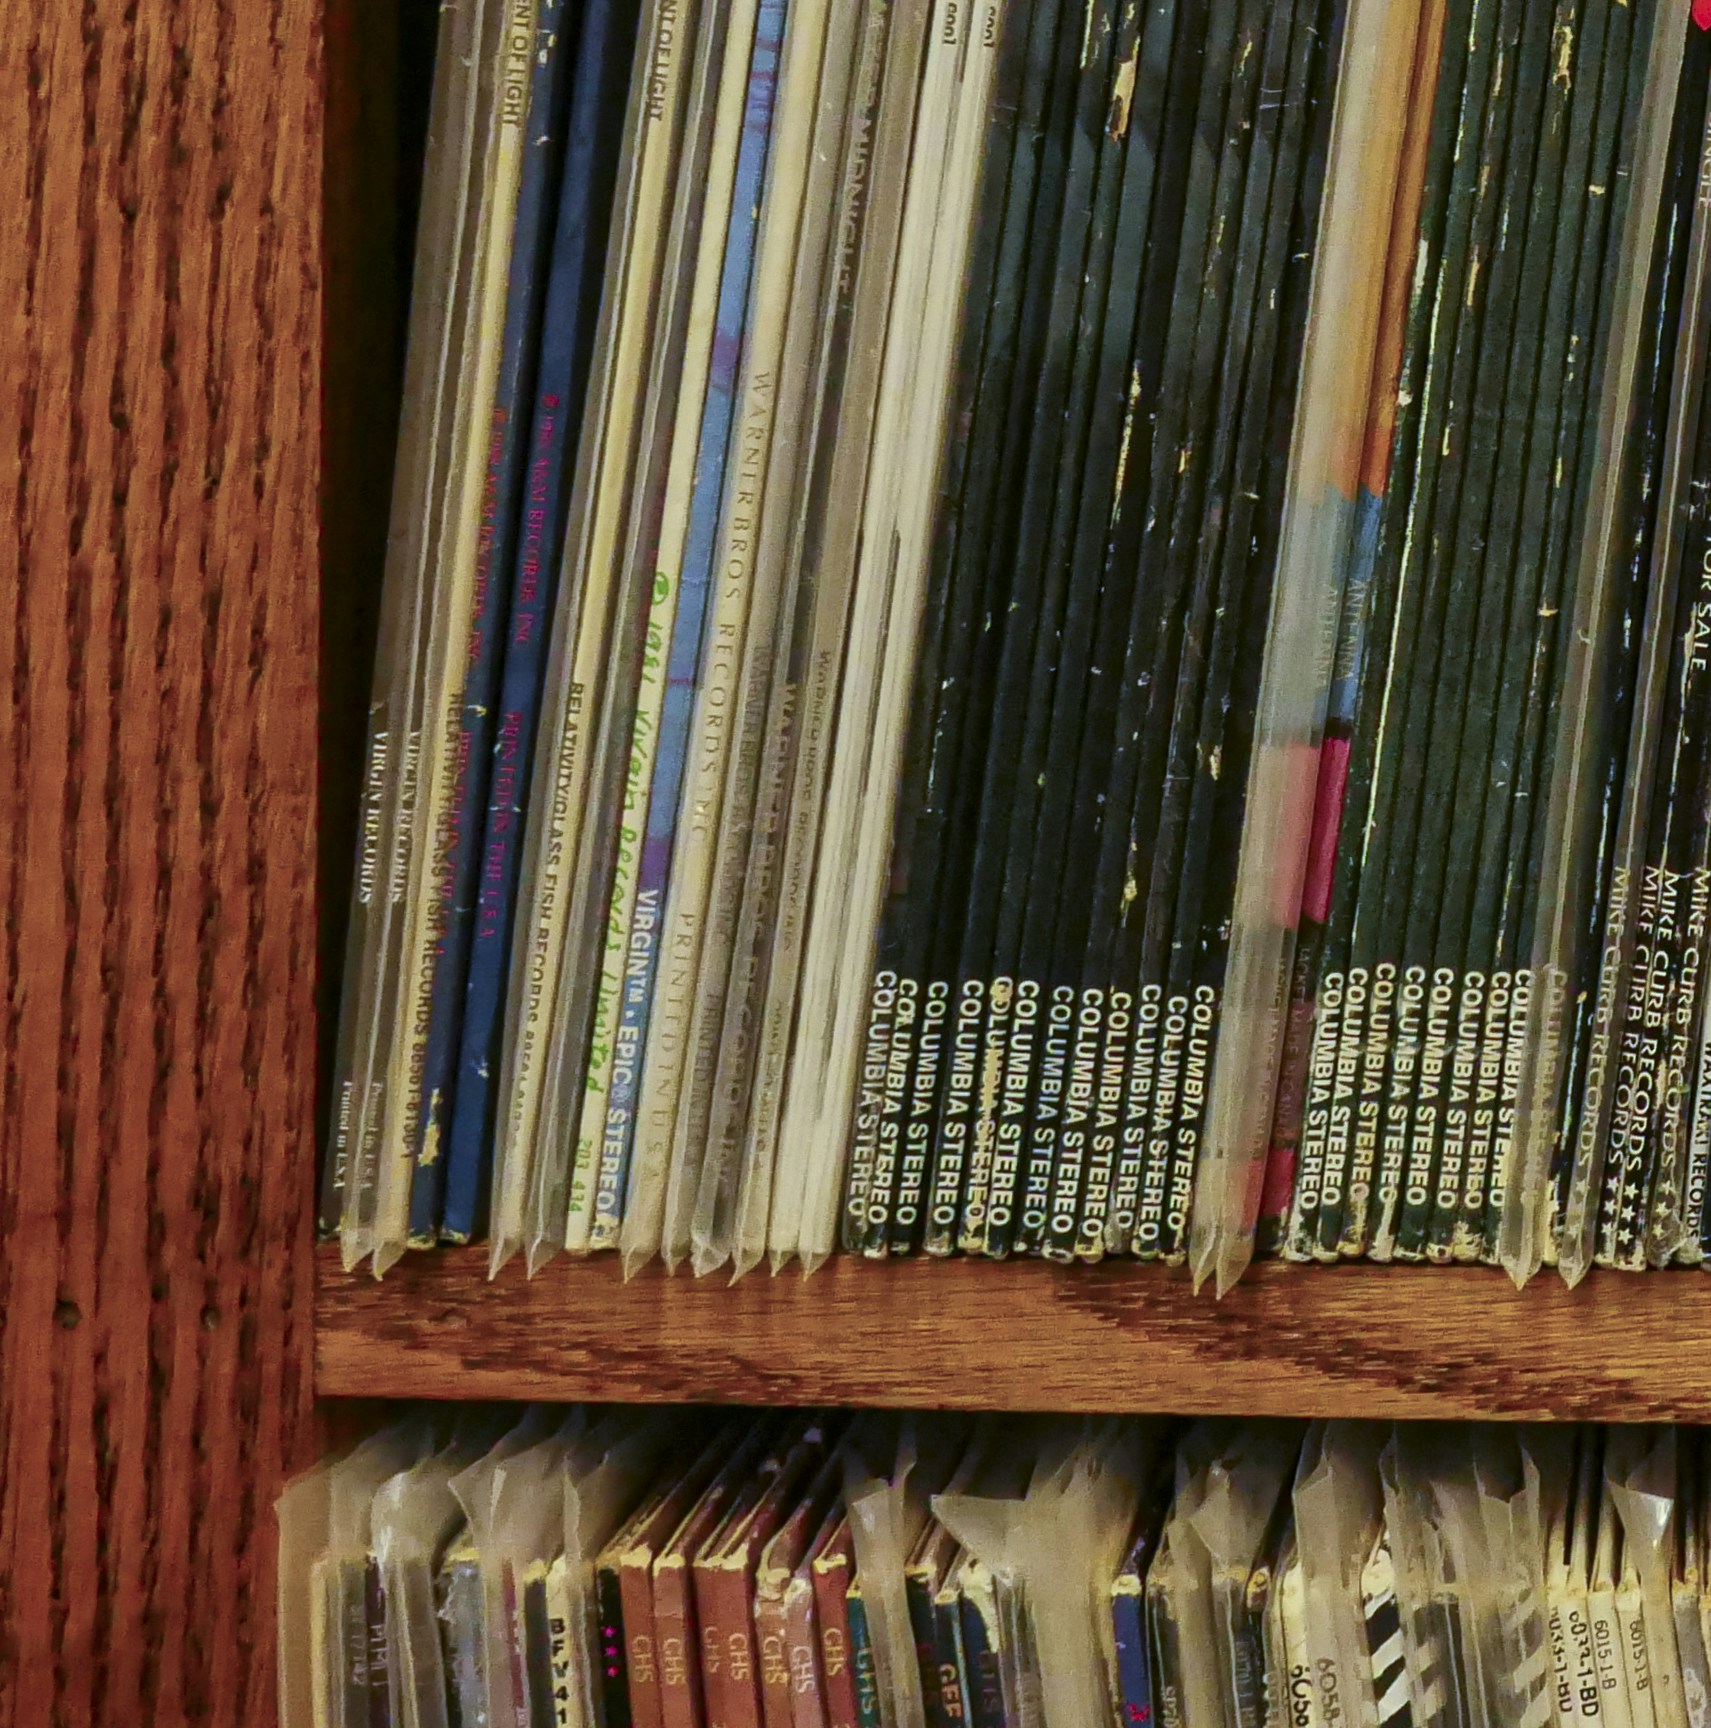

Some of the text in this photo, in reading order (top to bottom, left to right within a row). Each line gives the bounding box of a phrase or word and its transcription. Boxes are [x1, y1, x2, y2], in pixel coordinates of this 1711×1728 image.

[509, 35, 528, 62] OF
[501, 68, 524, 126] LIGHT
[1624, 868, 1680, 1172] MIKE CURB RECORDS
[894, 980, 947, 1226] COLUMBIA STEREO
[631, 1635, 654, 1683] GHS
[822, 1626, 846, 1675] GHS
